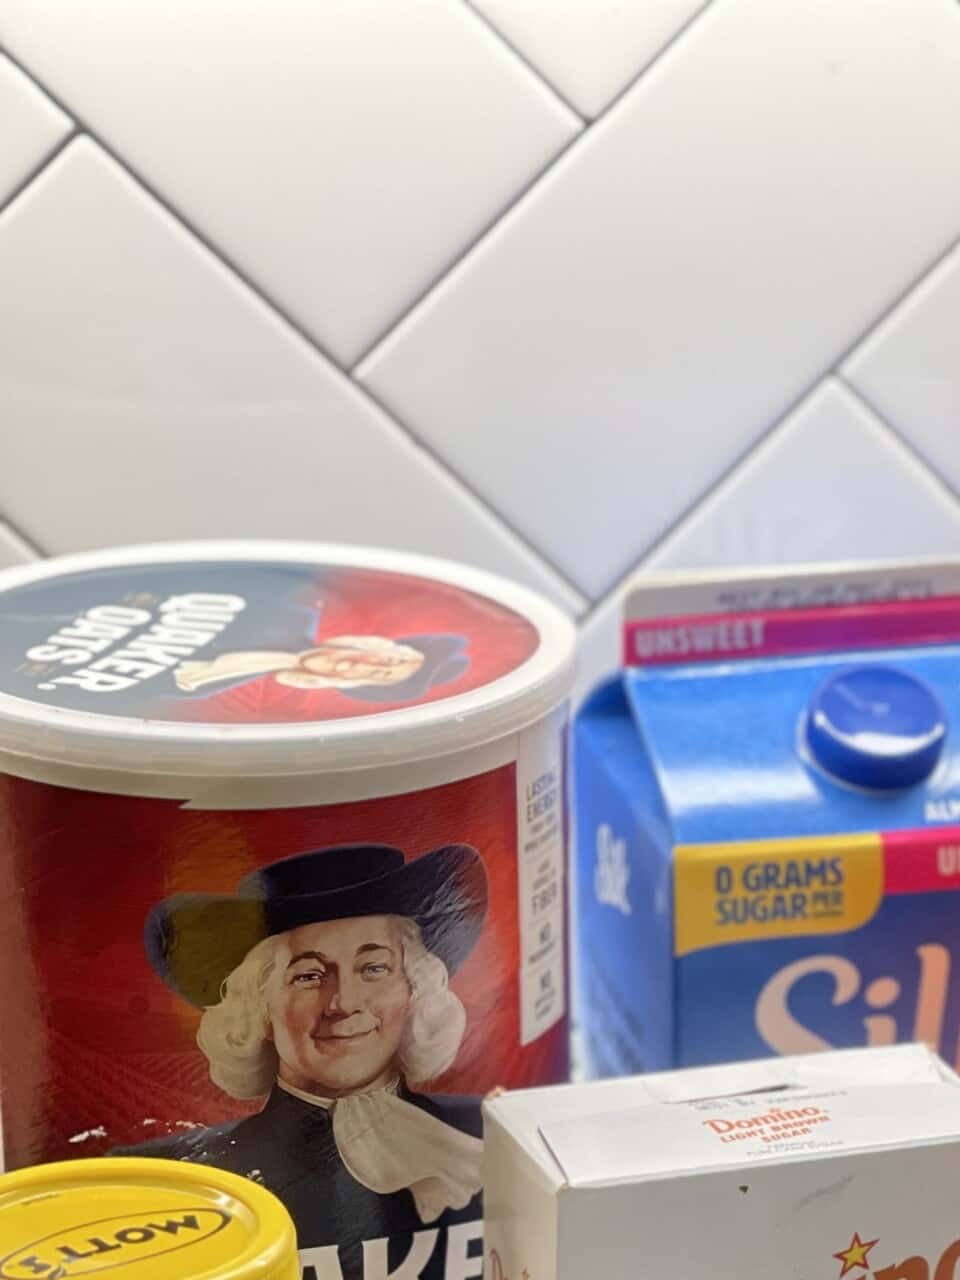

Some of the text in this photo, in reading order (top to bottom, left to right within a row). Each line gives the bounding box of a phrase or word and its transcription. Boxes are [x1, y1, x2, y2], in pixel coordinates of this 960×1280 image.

[26, 605, 152, 664] OATS
[50, 593, 246, 692] QUAKER
[634, 618, 765, 659] UNSWEET
[742, 858, 844, 893] GRAMS
[715, 894, 808, 926] SUGAR
[702, 1105, 822, 1134] Domino
[719, 1115, 832, 1143] LIGHT BROWN
[761, 1127, 812, 1143] SUGAR
[18, 1214, 201, 1280] MOTT'S
